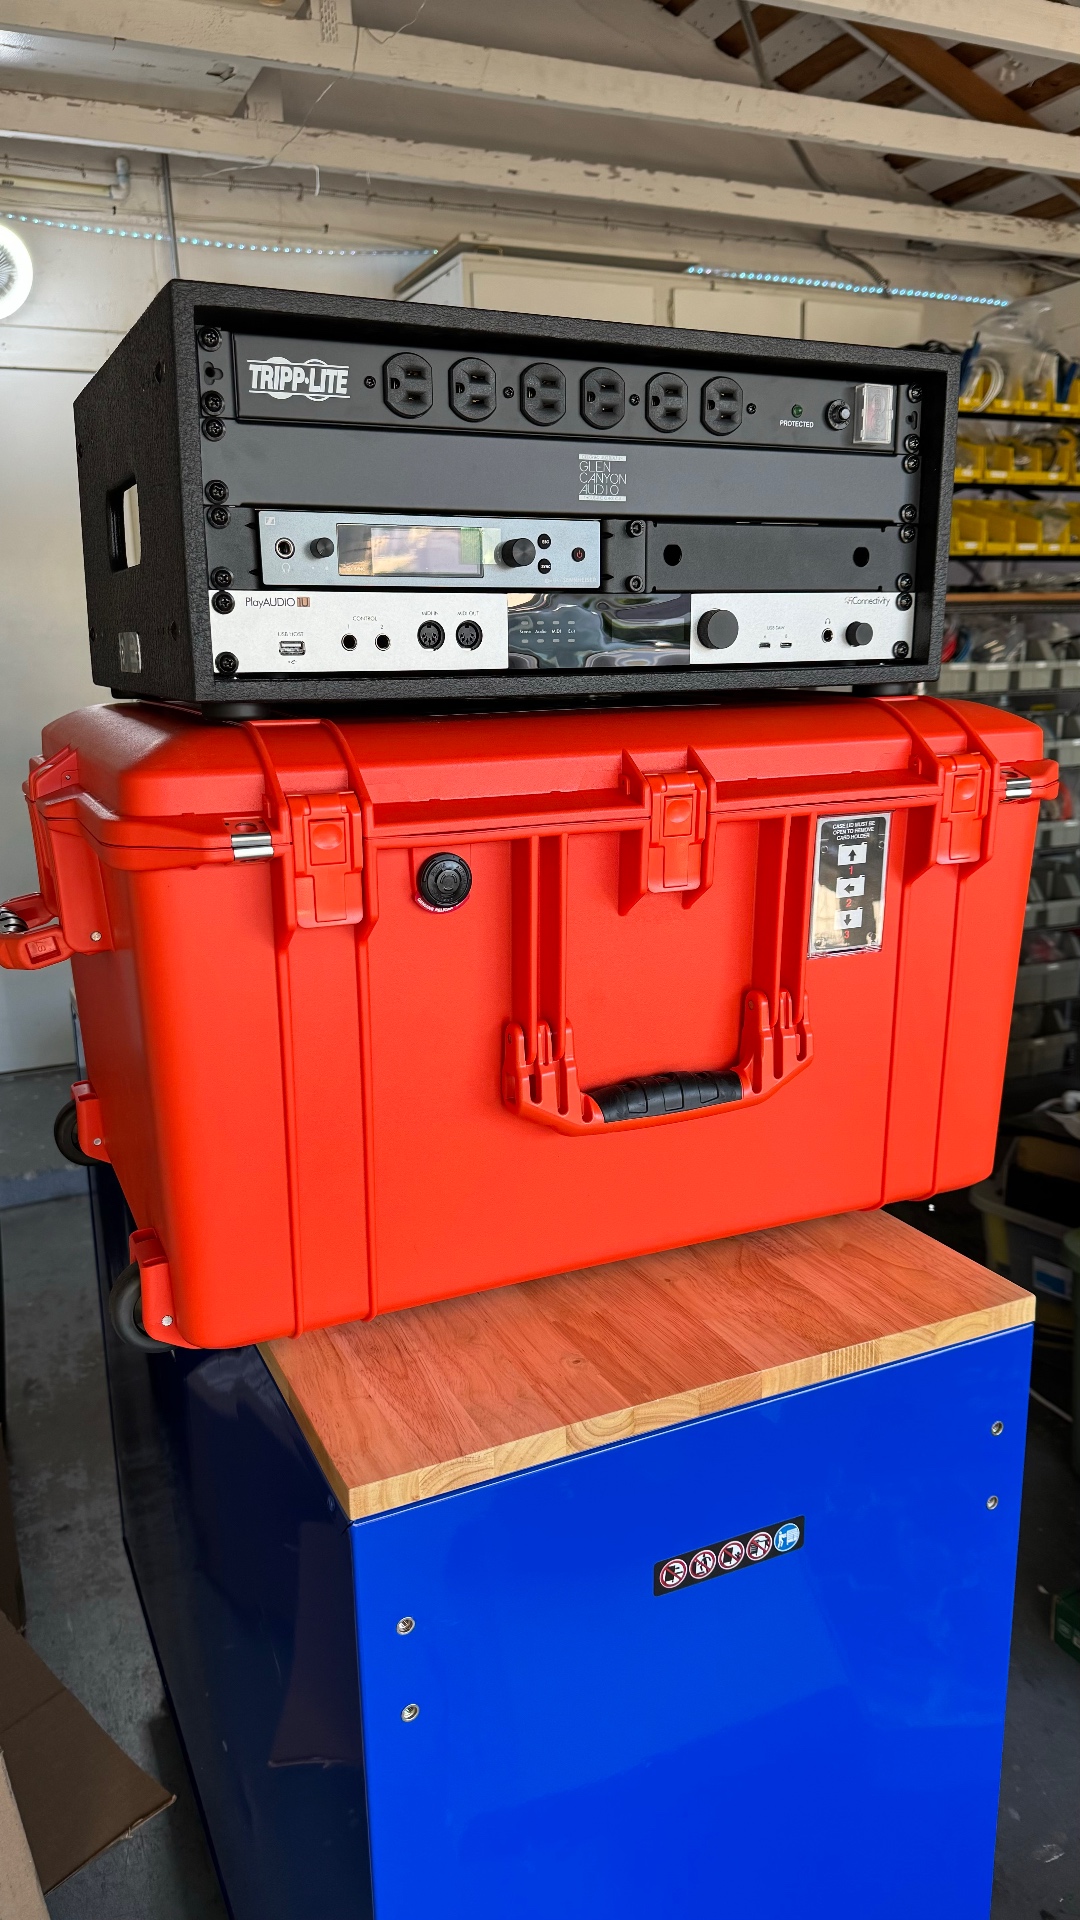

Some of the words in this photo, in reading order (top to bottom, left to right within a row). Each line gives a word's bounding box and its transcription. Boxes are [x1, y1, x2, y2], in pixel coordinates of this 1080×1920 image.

[780, 420, 814, 428] PROTECTED
[579, 460, 611, 473] GLEN
[579, 472, 627, 485] CANYON
[578, 484, 620, 496] AUDIO
[245, 596, 296, 609] PlayAUDIO
[832, 828, 847, 836] OPEN
[854, 826, 875, 834] REMOVE
[850, 832, 870, 840] HOLDER
[848, 865, 854, 875] 1
[845, 898, 852, 908] 2
[843, 930, 850, 939] 3
